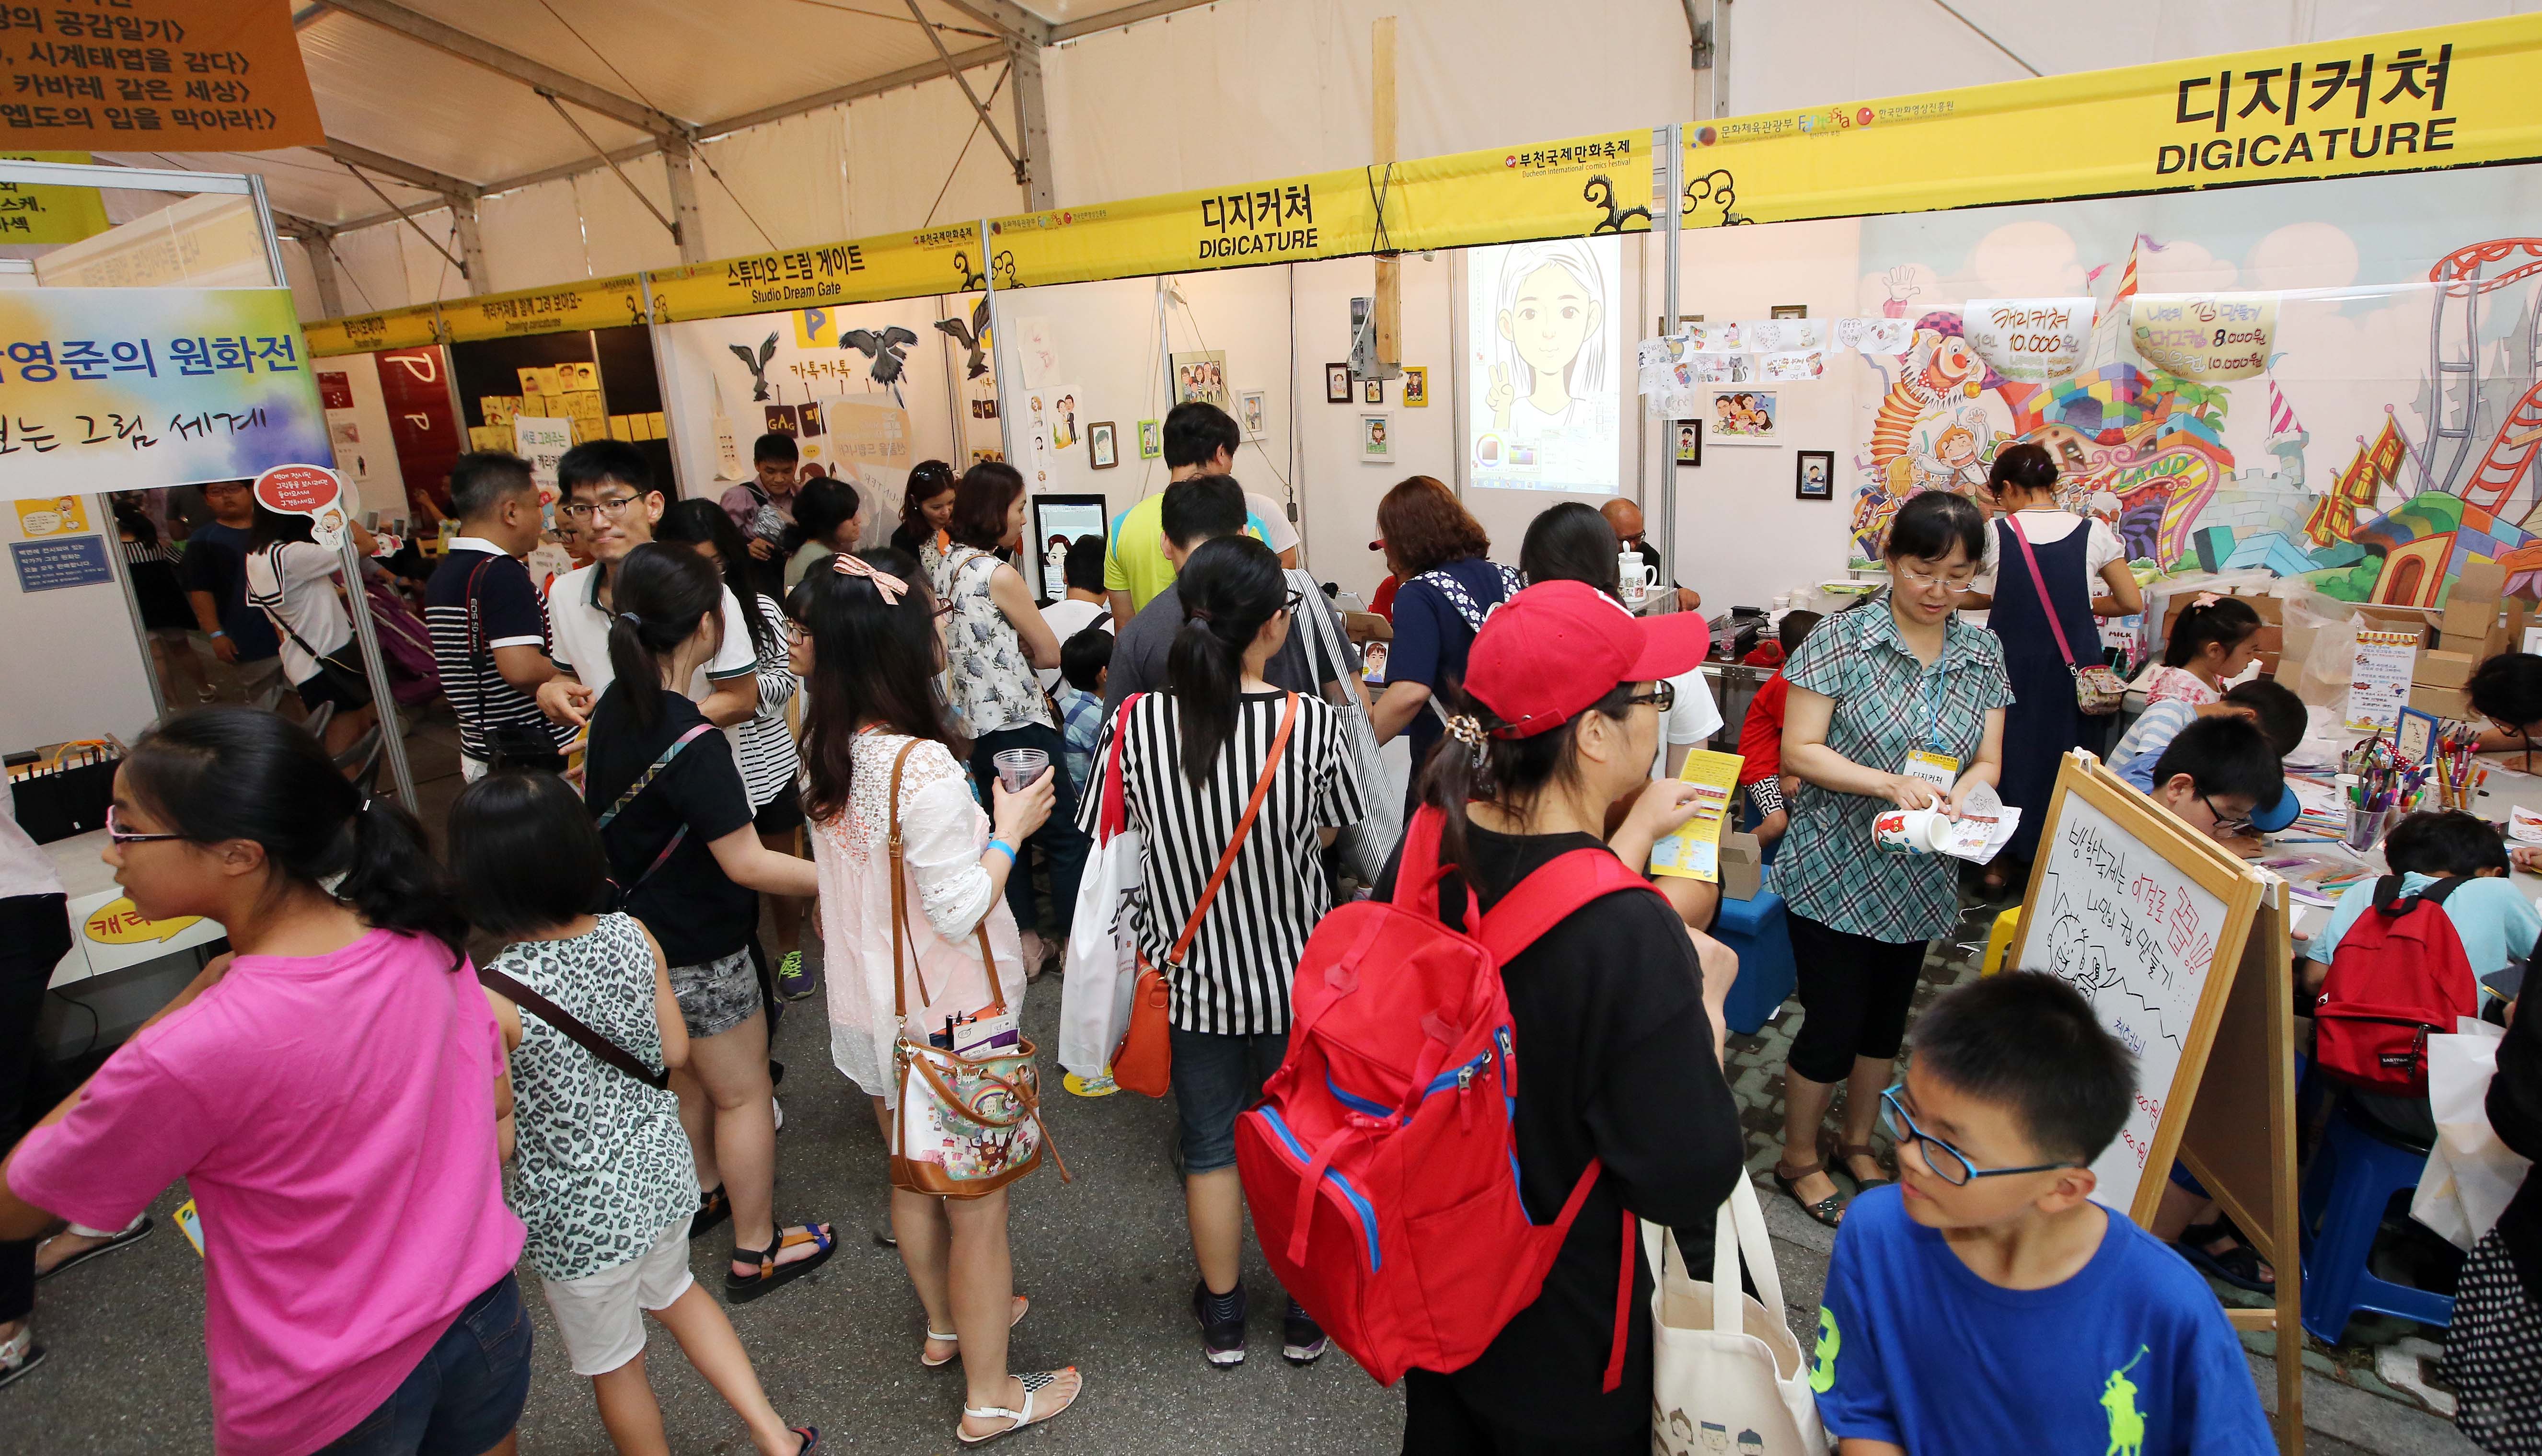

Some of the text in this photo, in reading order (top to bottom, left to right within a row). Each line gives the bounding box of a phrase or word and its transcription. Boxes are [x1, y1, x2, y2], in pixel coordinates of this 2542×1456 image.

[29, 42, 173, 73] 시계태엽을
[13, 74, 105, 100] 카바레
[115, 78, 173, 101] 같은
[2176, 44, 2453, 132] 디지커쳐
[104, 107, 163, 130] 입을
[1721, 118, 1793, 139] 문화체육관광부
[1519, 139, 1630, 168] 부천국제만화축제
[2156, 117, 2457, 175] DIGICATURE
[1548, 163, 1584, 174] international
[1585, 162, 1606, 170] comics
[1202, 183, 1313, 233] 디지커쳐
[920, 227, 972, 245] 부천국제만화축제
[1002, 218, 1035, 231] 문화체육관광부
[1199, 228, 1319, 259] DIGICATURE
[727, 245, 866, 288] 스튜디오 드림 게이트
[752, 281, 841, 304] Studio Dream Gate
[1992, 307, 2071, 330] 캐리커쳐
[2219, 303, 2262, 323] 만들기
[169, 335, 299, 376] 원화전
[790, 360, 851, 380] 카톡카톡
[75, 413, 159, 451] 그림
[169, 408, 266, 441] 세계
[768, 414, 795, 431] GAG
[2118, 455, 2188, 489] LAND
[472, 622, 479, 632] 5D
[2069, 818, 2125, 894] 방학숙제는
[2132, 873, 2167, 924] 이걸로
[2087, 889, 2173, 991] 나만의 컵 만들기
[2114, 1017, 2146, 1059] 체험비
